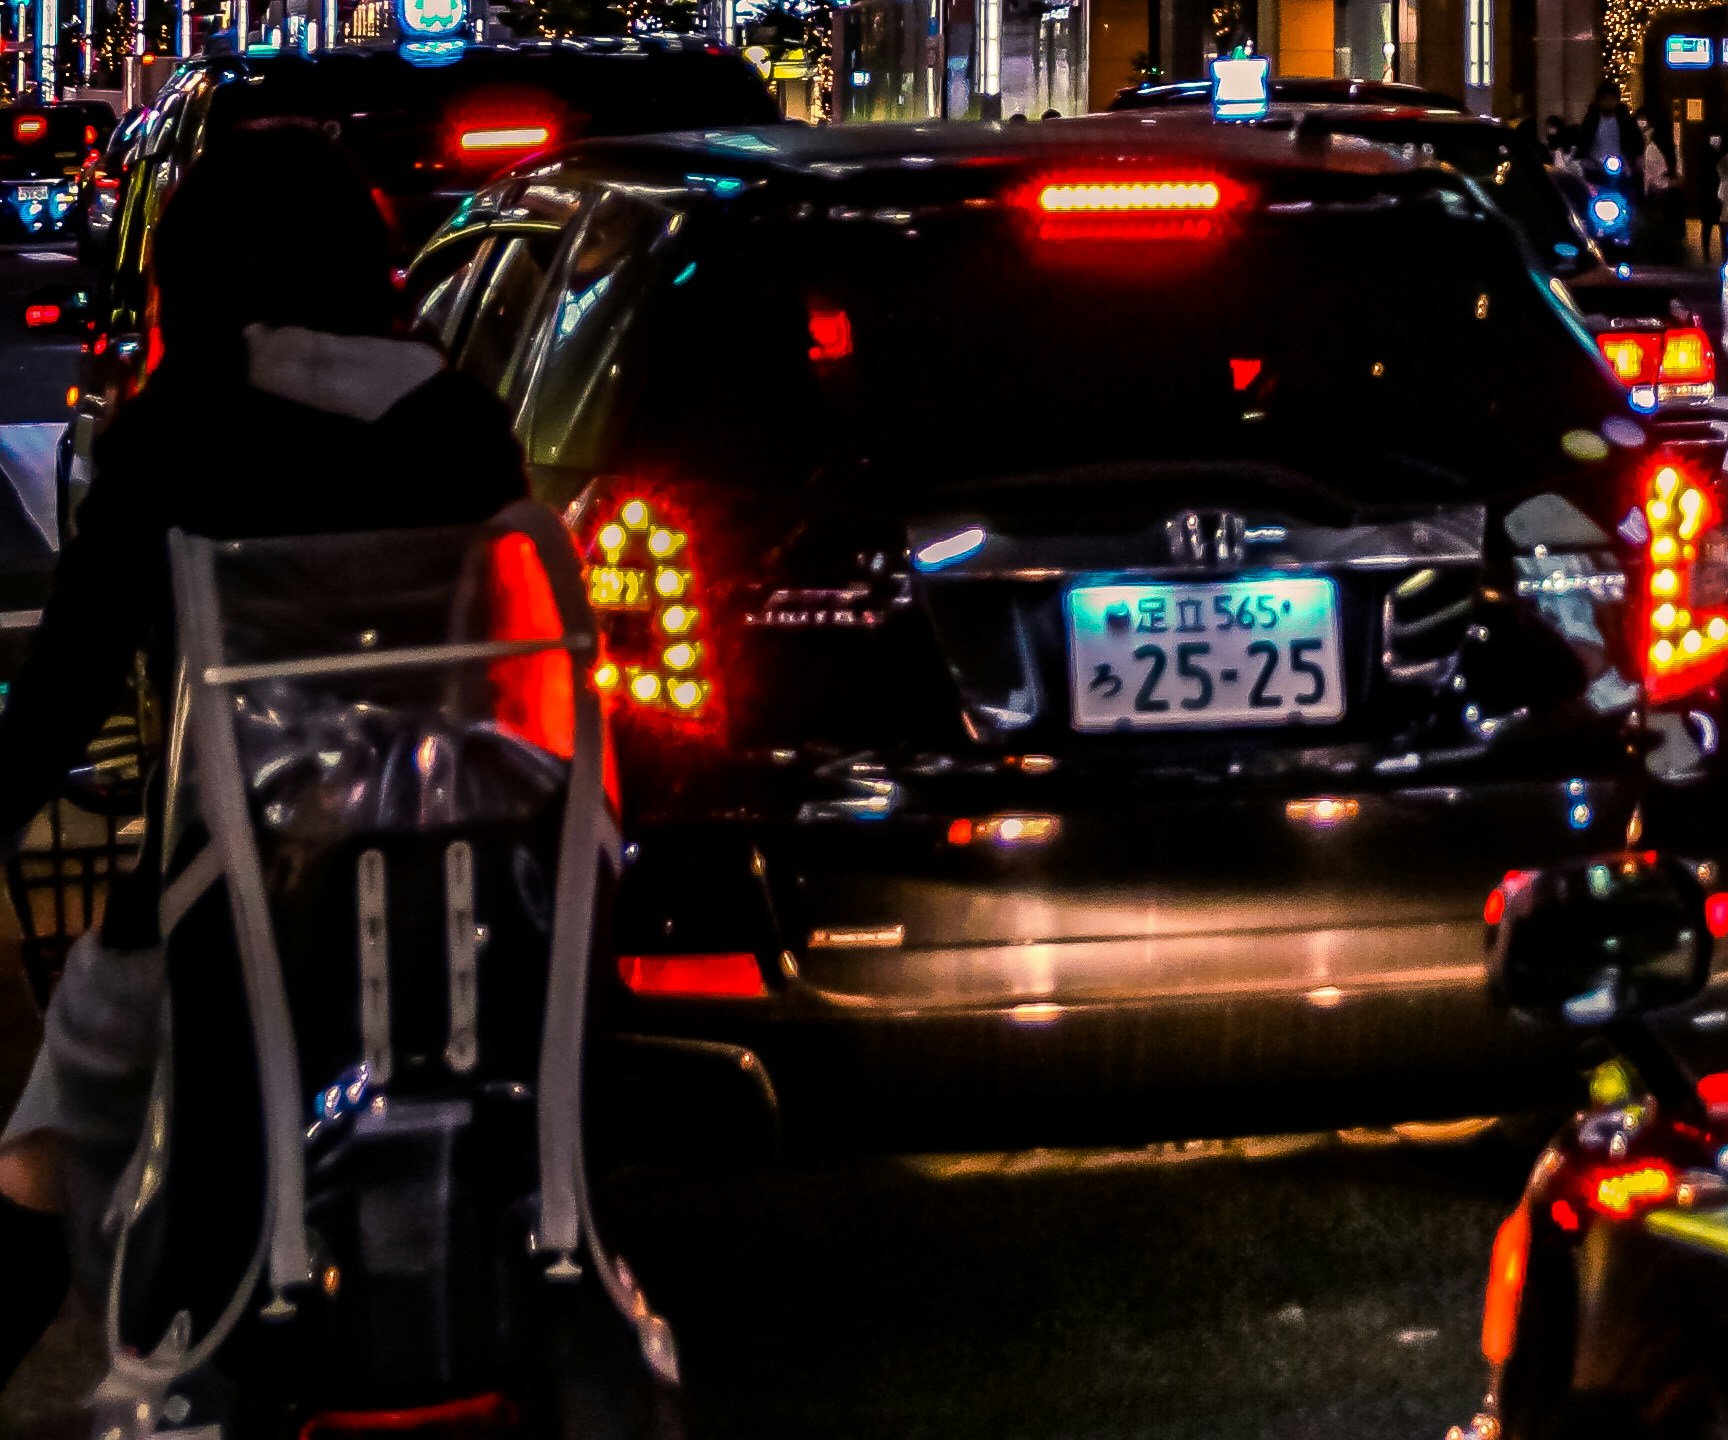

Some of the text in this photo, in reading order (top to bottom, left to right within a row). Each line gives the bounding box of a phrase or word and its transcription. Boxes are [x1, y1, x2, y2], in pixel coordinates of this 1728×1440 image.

[1136, 593, 1278, 634] 足立 565
[1132, 637, 1327, 713] 25-25
